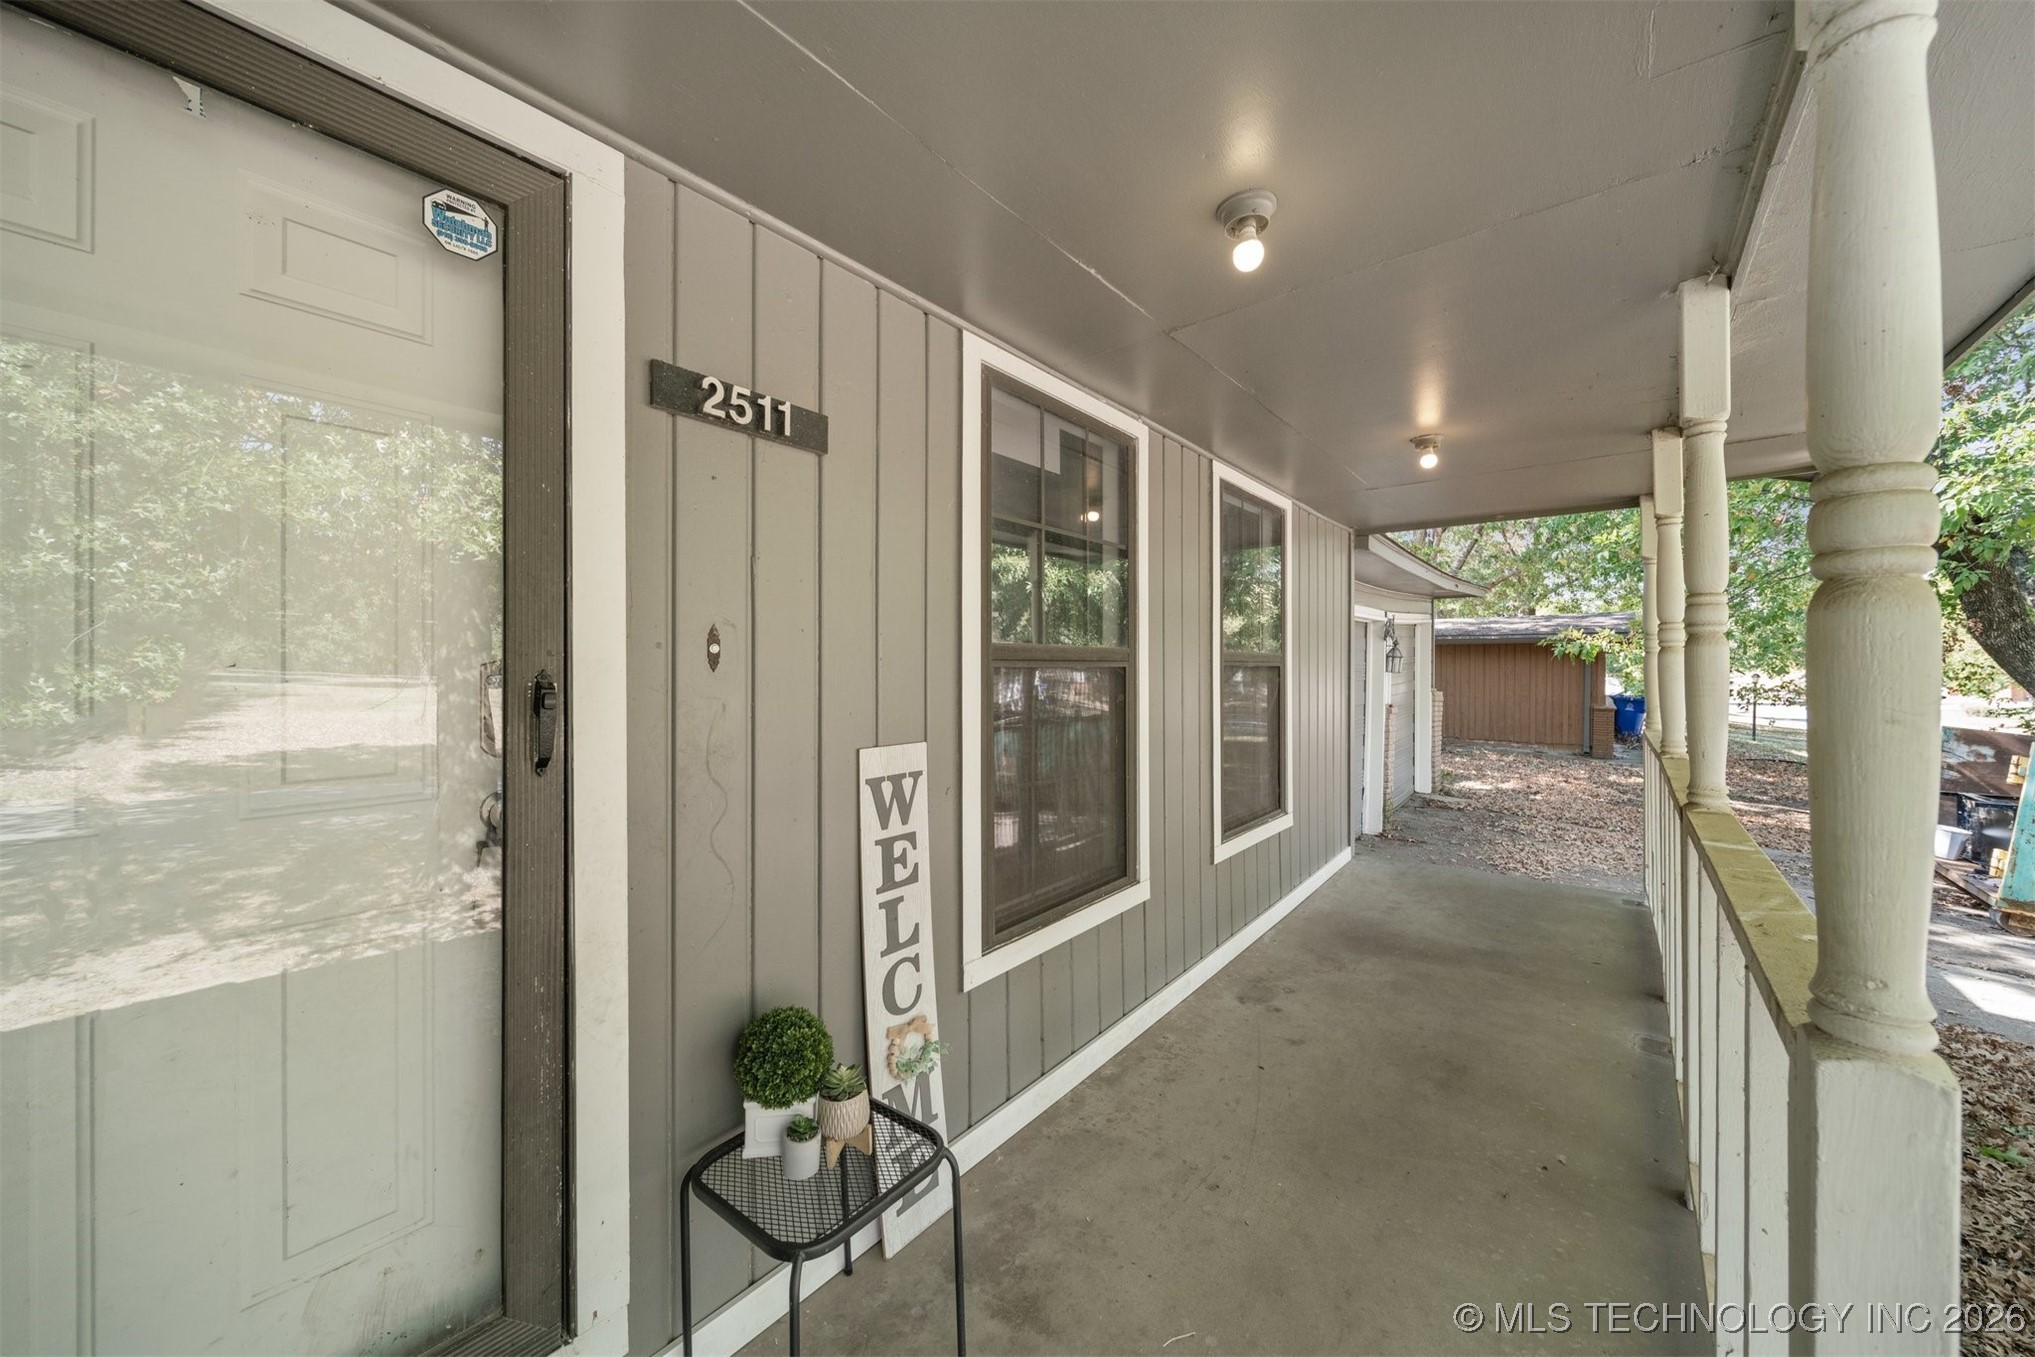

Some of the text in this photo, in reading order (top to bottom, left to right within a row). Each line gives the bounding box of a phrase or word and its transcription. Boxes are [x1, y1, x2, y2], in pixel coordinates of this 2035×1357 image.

[446, 193, 476, 209] WARNING
[432, 218, 476, 241] SECURITY
[701, 376, 791, 436] 2511
